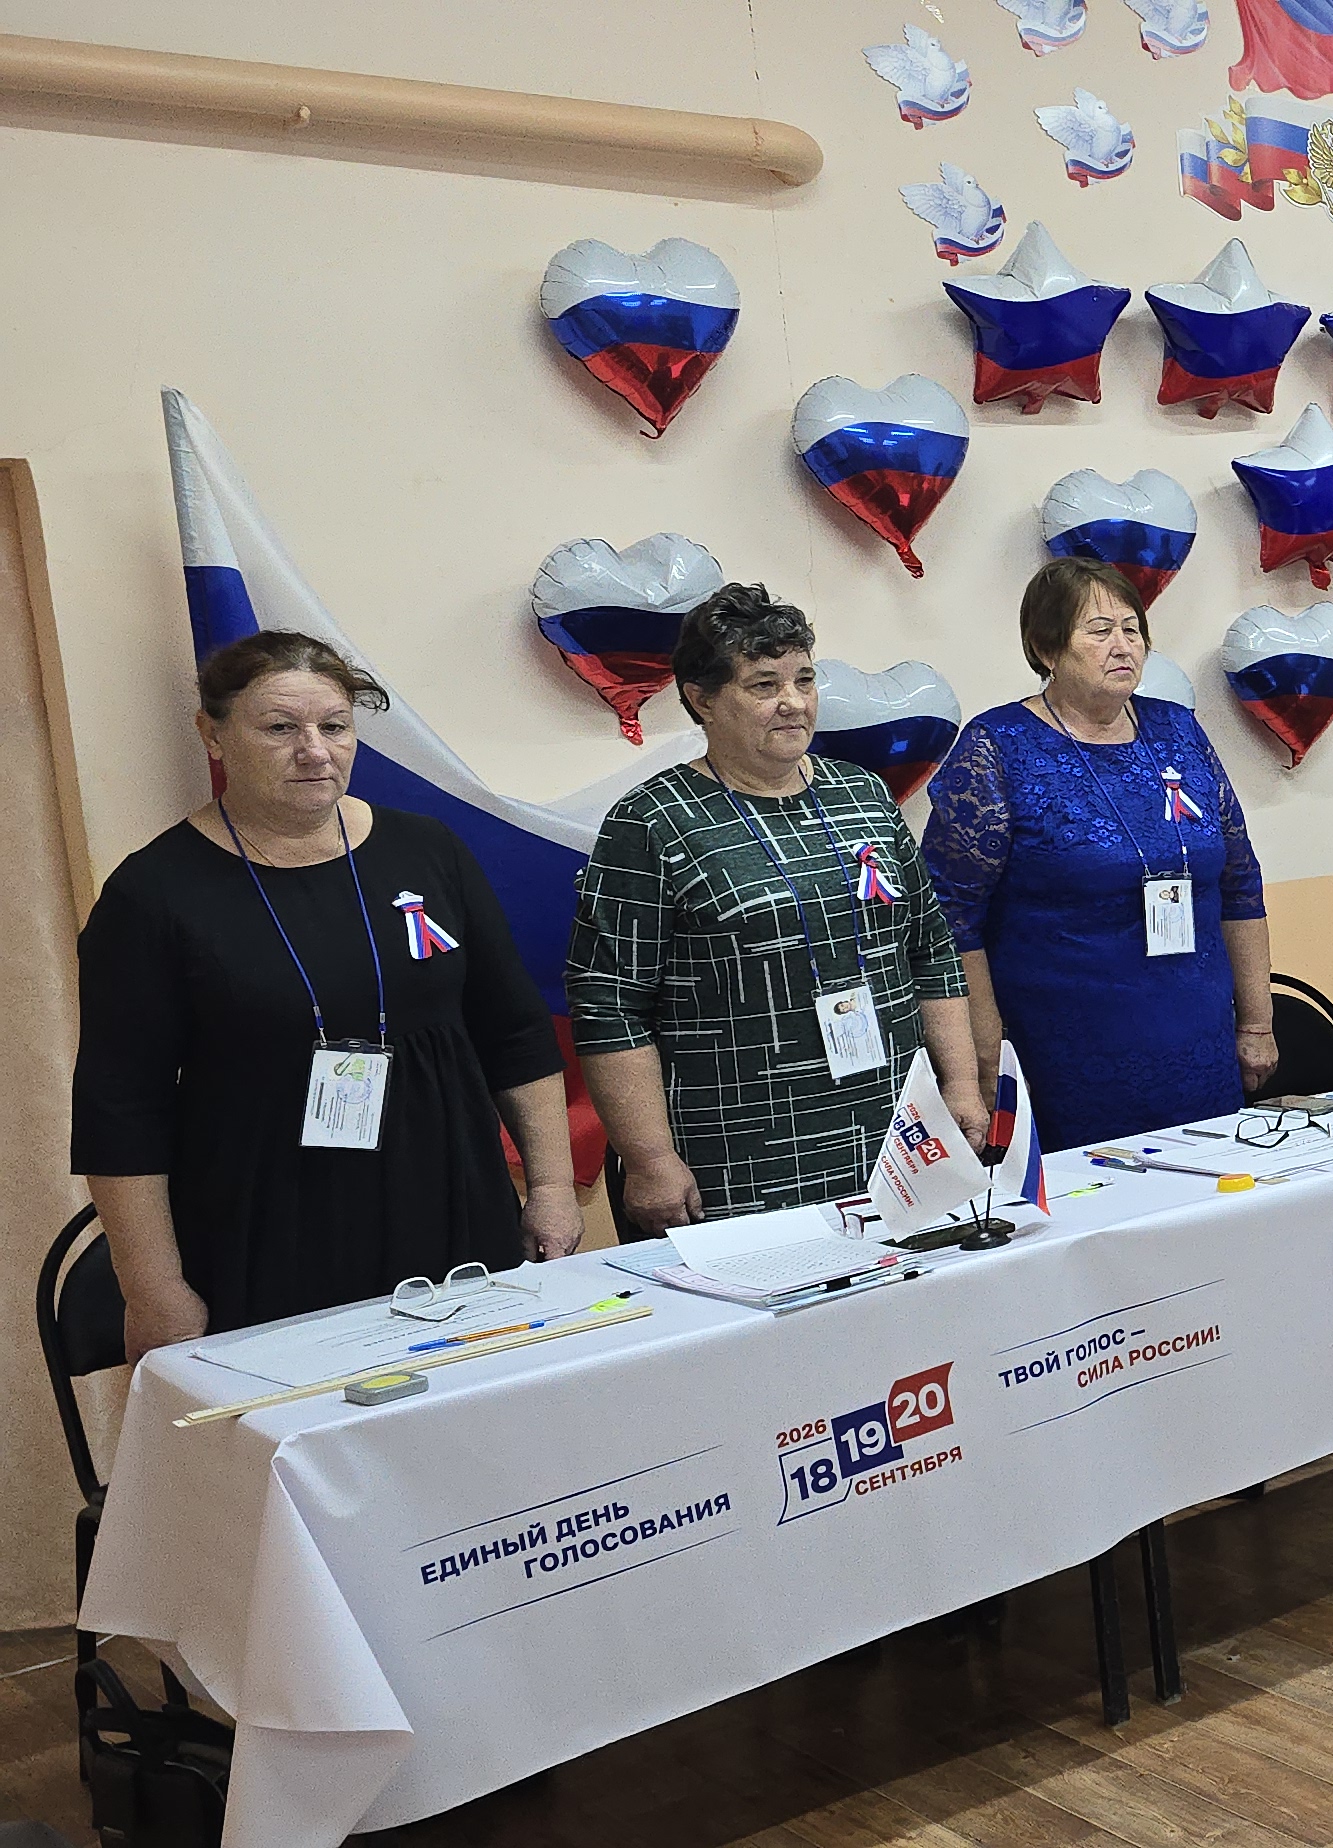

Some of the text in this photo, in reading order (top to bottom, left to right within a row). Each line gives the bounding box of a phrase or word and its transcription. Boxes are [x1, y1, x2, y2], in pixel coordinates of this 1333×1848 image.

[894, 1137, 919, 1175] СЕНТЯБРЯ
[906, 1126, 922, 1144] 19
[921, 1141, 941, 1160] 20
[998, 1351, 1061, 1388] ТВОЙ
[1066, 1328, 1126, 1366] ГОЛОС
[1077, 1325, 1221, 1388] СИЛА РОССИИ!
[775, 1419, 827, 1449] 2026
[790, 1382, 945, 1500] 18 19 20
[854, 1445, 963, 1496] СЕНТЯБРЯ
[420, 1502, 630, 1585] ЕДИНЫЙ ДЕНЬ
[524, 1493, 732, 1579] ГОЛОСОВАНИЯ
